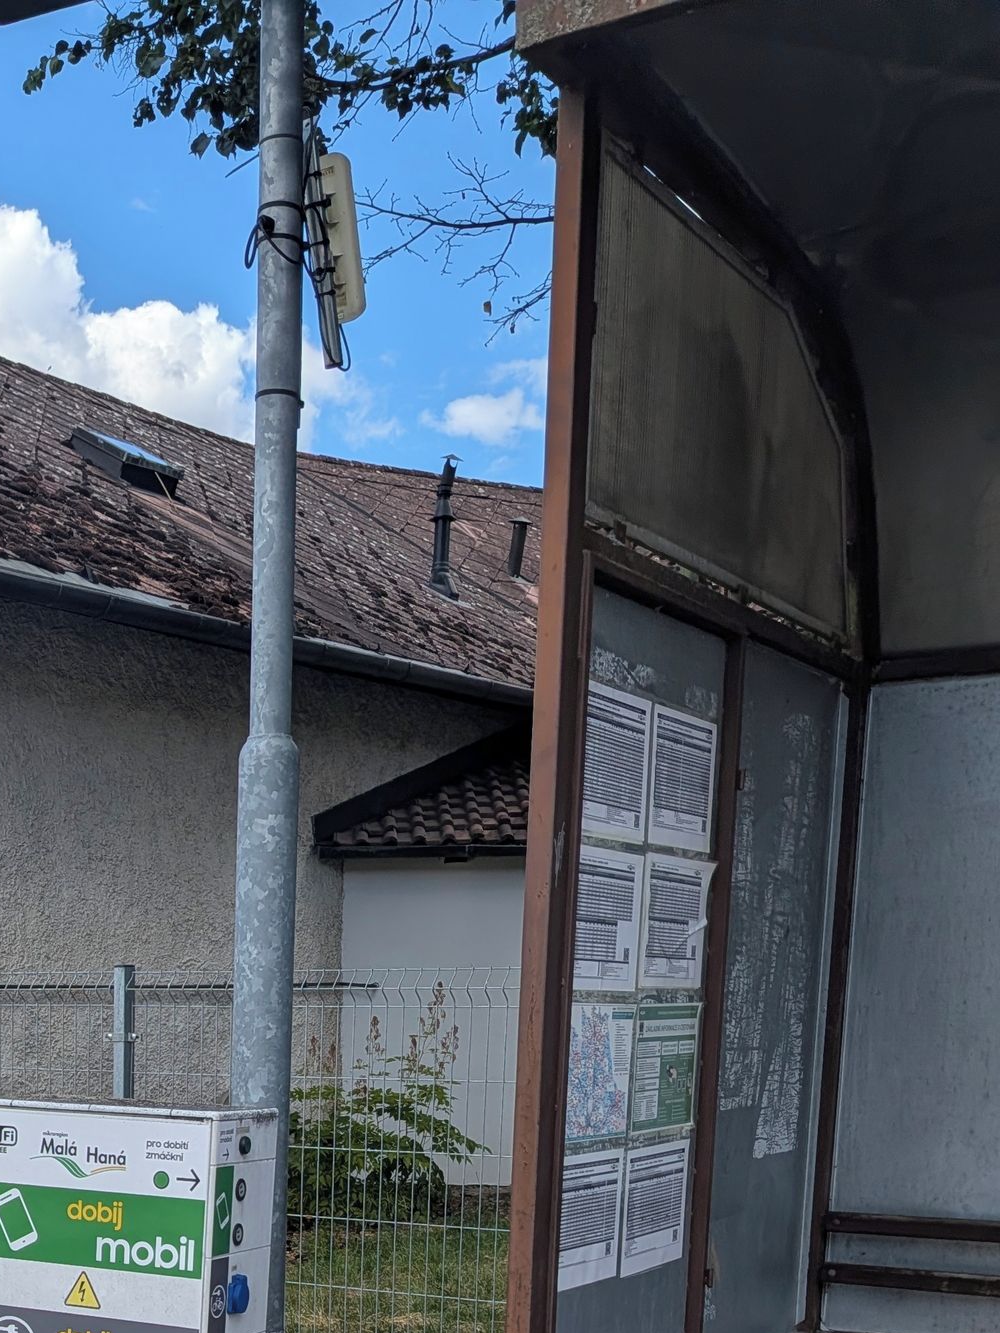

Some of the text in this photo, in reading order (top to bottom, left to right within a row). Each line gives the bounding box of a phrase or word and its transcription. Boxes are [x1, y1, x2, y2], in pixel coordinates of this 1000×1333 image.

[41, 1137, 126, 1166] Malá Haná
[145, 1150, 184, 1161] zmáčkni
[146, 1140, 189, 1150] pro dobití
[67, 1200, 123, 1231] dobij
[96, 1236, 195, 1272] mobil
